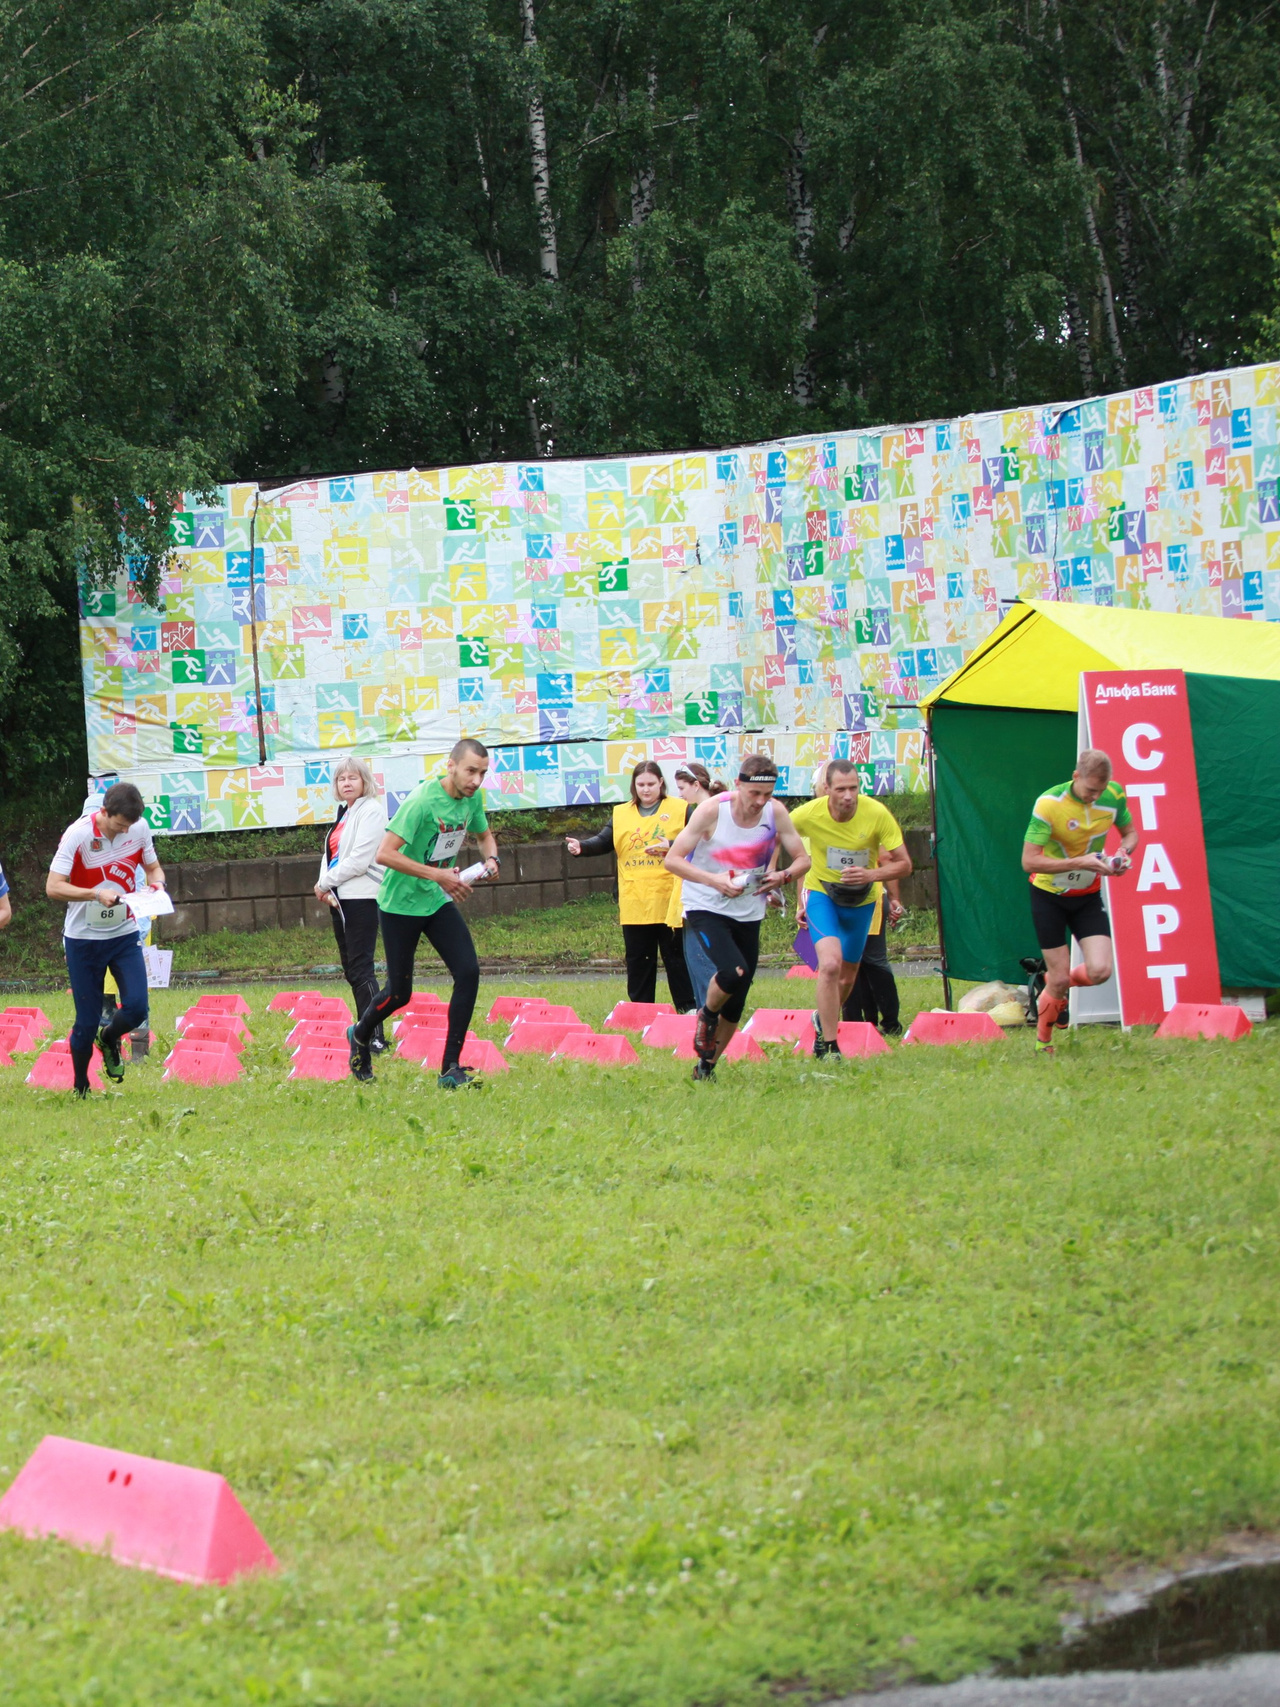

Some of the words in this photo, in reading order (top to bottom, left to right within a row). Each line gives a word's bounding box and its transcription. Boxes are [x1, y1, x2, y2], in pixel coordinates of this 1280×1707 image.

[1095, 683, 1140, 701] Альфа
[1141, 682, 1177, 697] Банк
[444, 840, 455, 850] 66
[624, 859, 663, 867] АЗИМУ
[840, 857, 854, 865] 63
[109, 864, 128, 880] Run
[1121, 722, 1187, 1013] СТАРТ
[1067, 872, 1081, 882] 61
[100, 909, 114, 919] 68
